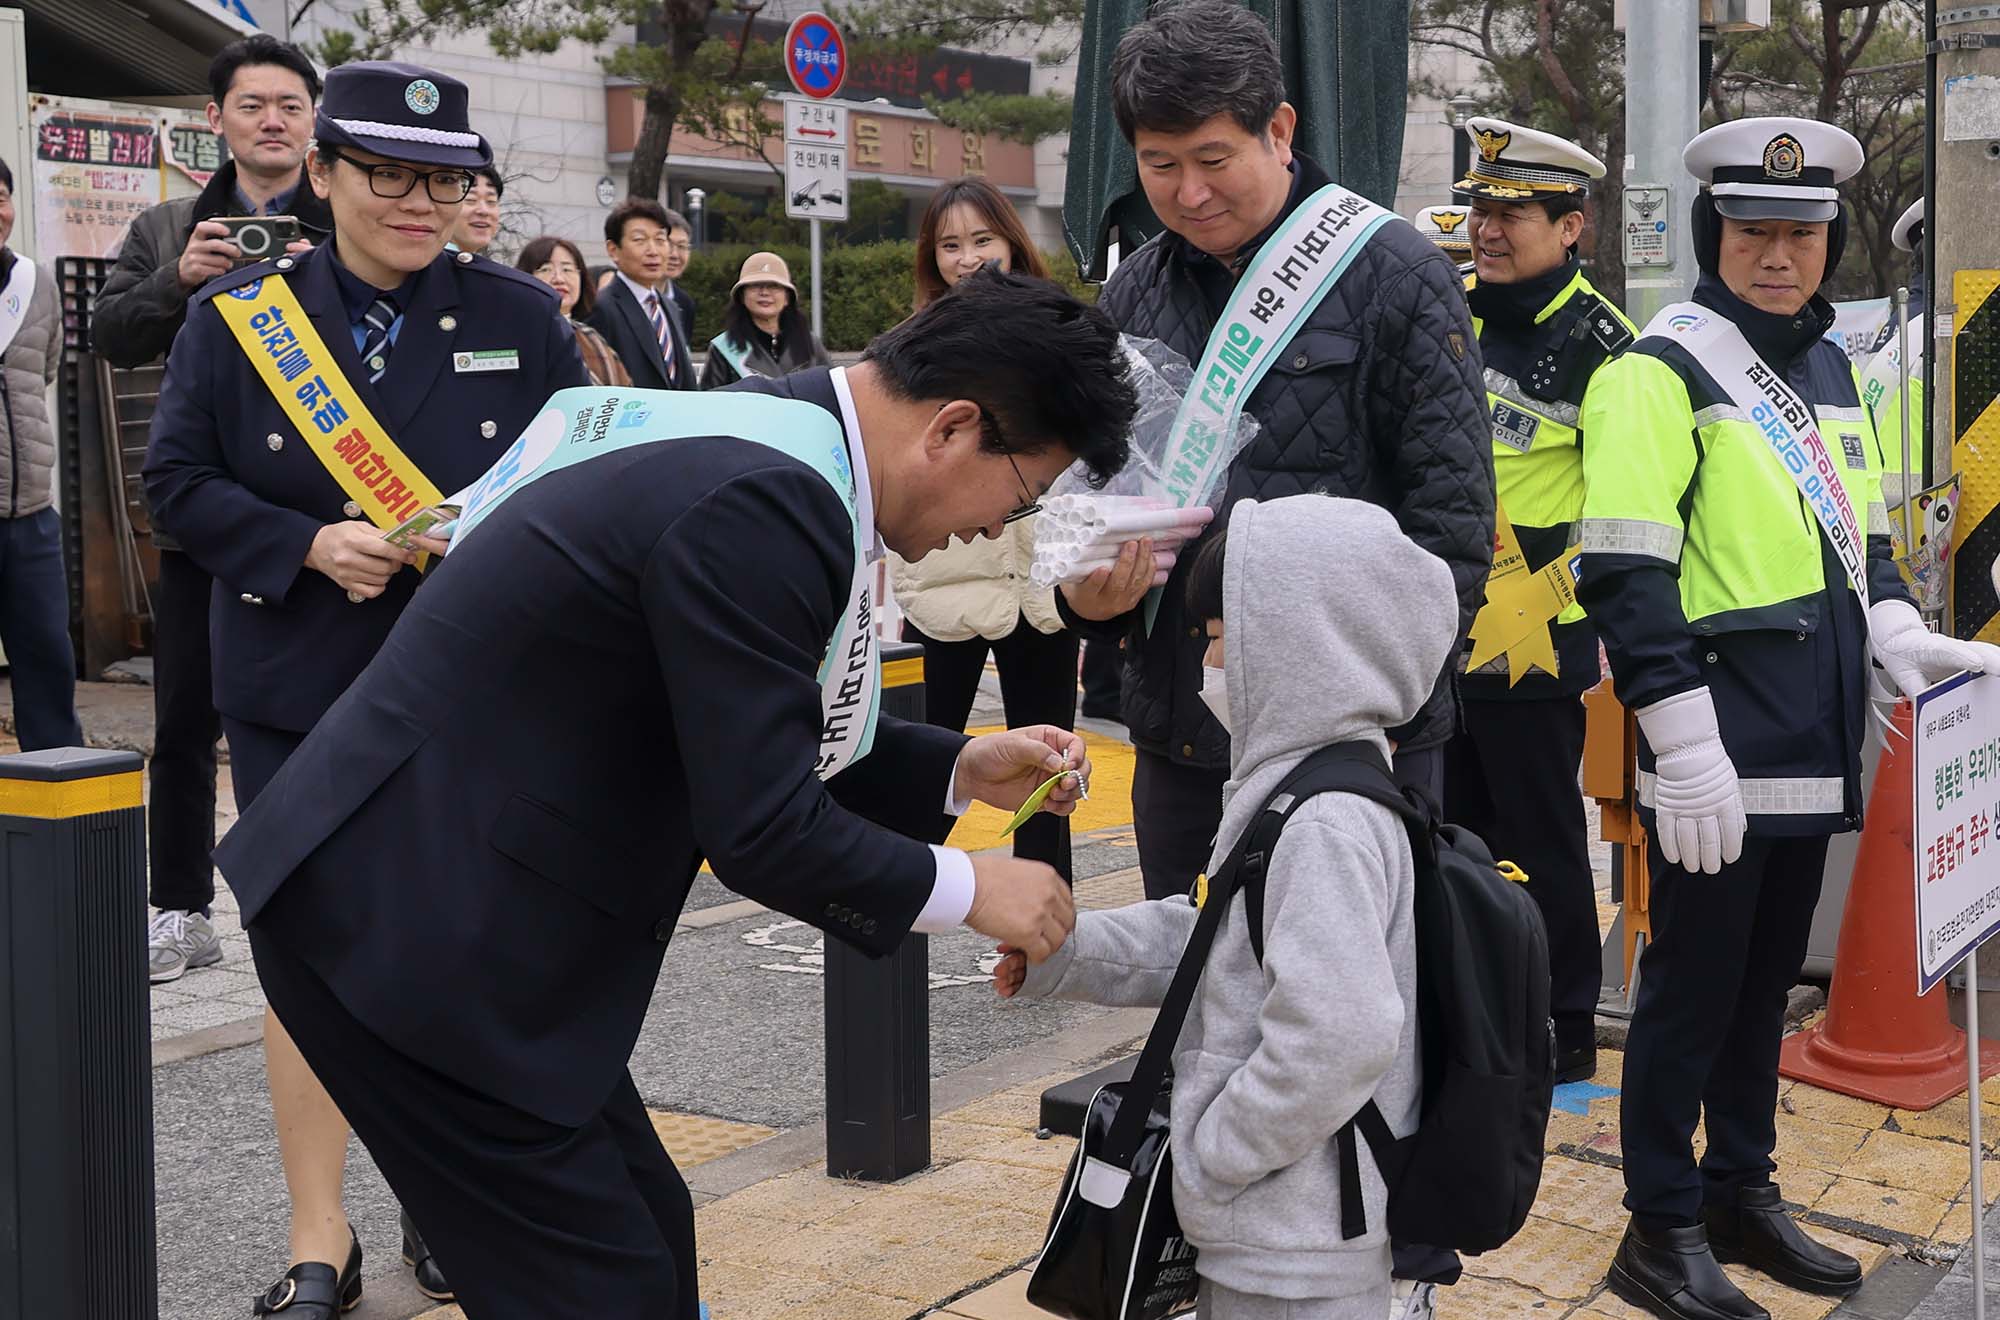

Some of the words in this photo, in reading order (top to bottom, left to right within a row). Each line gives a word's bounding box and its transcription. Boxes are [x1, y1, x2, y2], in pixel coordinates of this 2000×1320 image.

[794, 150, 841, 170] 견인지역
[1271, 195, 1370, 292] 횡단보도
[1250, 286, 1285, 324] 앞
[249, 304, 313, 382] 안전을
[295, 374, 350, 434] 위해
[1200, 322, 1263, 415] 일단
[1744, 361, 1809, 432] 편리한
[589, 397, 619, 443] 아이먼저
[1752, 400, 1810, 475] 안전이
[1934, 754, 1963, 812] 행복한
[1927, 823, 1965, 883] 교통법규
[1970, 808, 1989, 856] 준수
